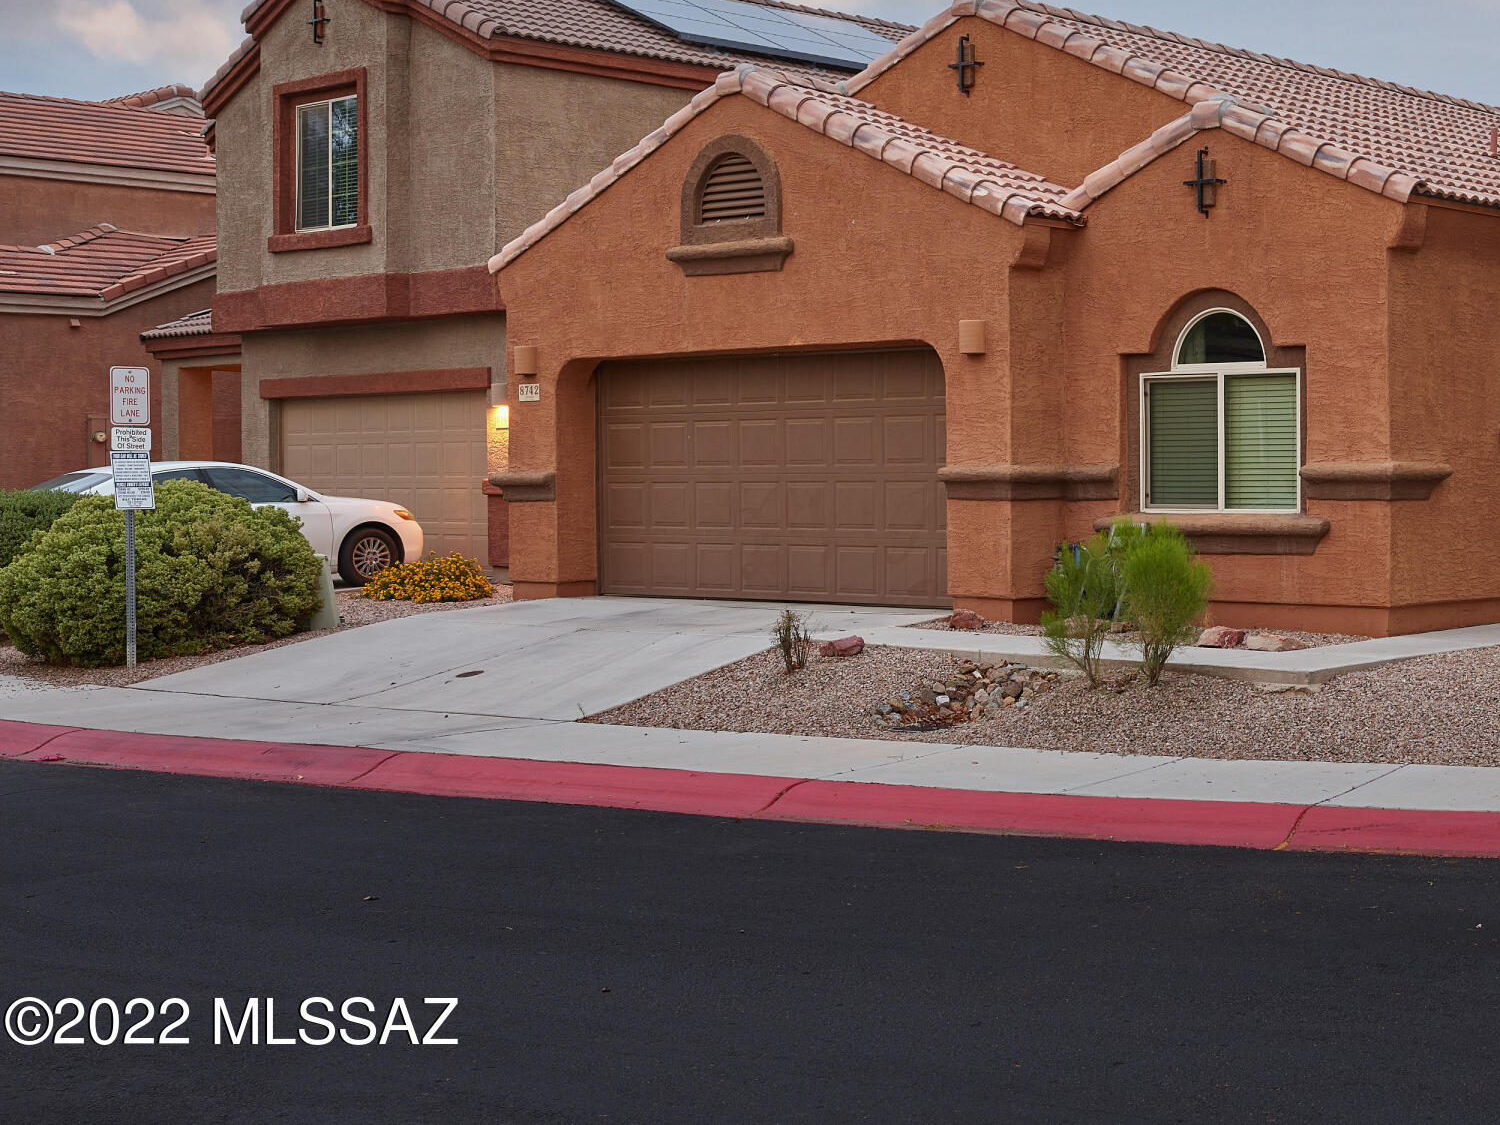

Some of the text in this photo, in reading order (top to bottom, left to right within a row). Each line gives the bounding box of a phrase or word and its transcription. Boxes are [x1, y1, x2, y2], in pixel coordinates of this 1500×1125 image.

[124, 375, 135, 383] NO
[114, 386, 146, 395] PARKING
[120, 409, 140, 417] LANE
[115, 428, 147, 436] Prohibited
